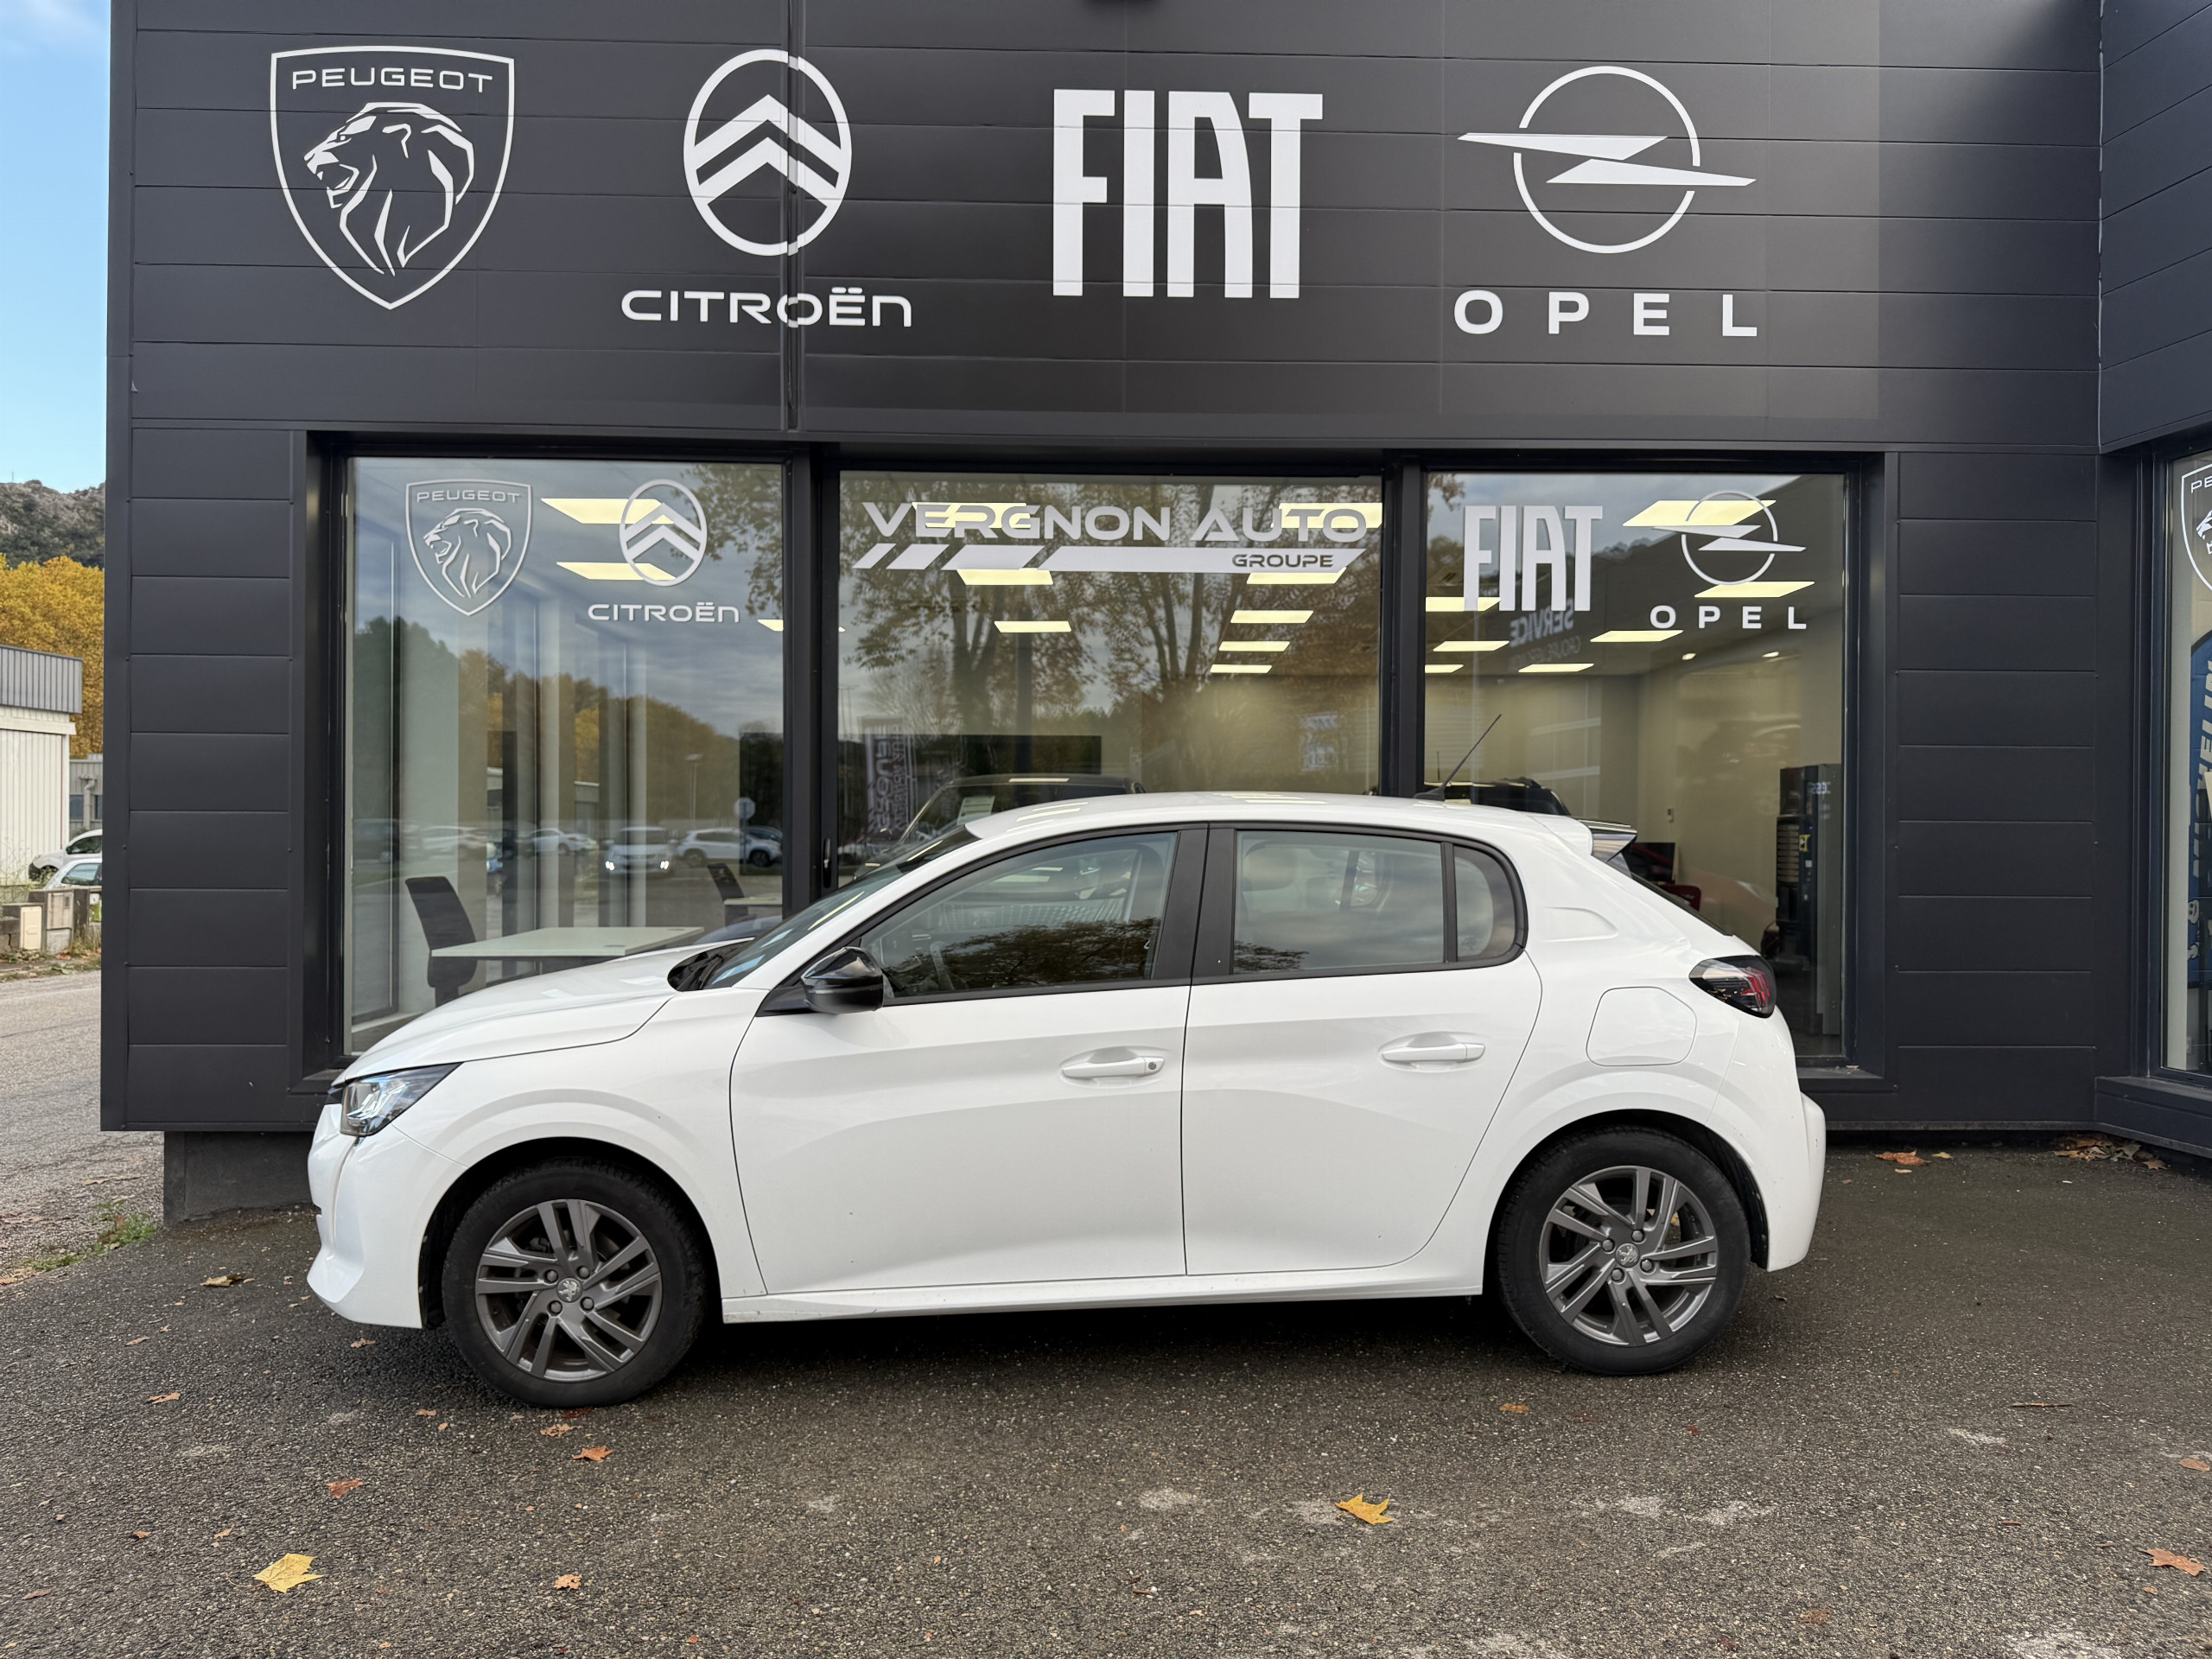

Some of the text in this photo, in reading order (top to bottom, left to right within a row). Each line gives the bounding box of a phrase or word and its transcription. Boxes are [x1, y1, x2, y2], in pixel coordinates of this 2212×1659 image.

[292, 67, 493, 93] PEUGEOT
[1052, 89, 1324, 299] FIAT
[1453, 289, 1758, 337] OPEL
[416, 488, 521, 504] PEUGEOT
[861, 501, 1368, 543] VERGNON AUTO
[1231, 554, 1334, 568] GROUPE
[1463, 505, 1604, 612] FIAT
[1649, 605, 1808, 630] OPEL
